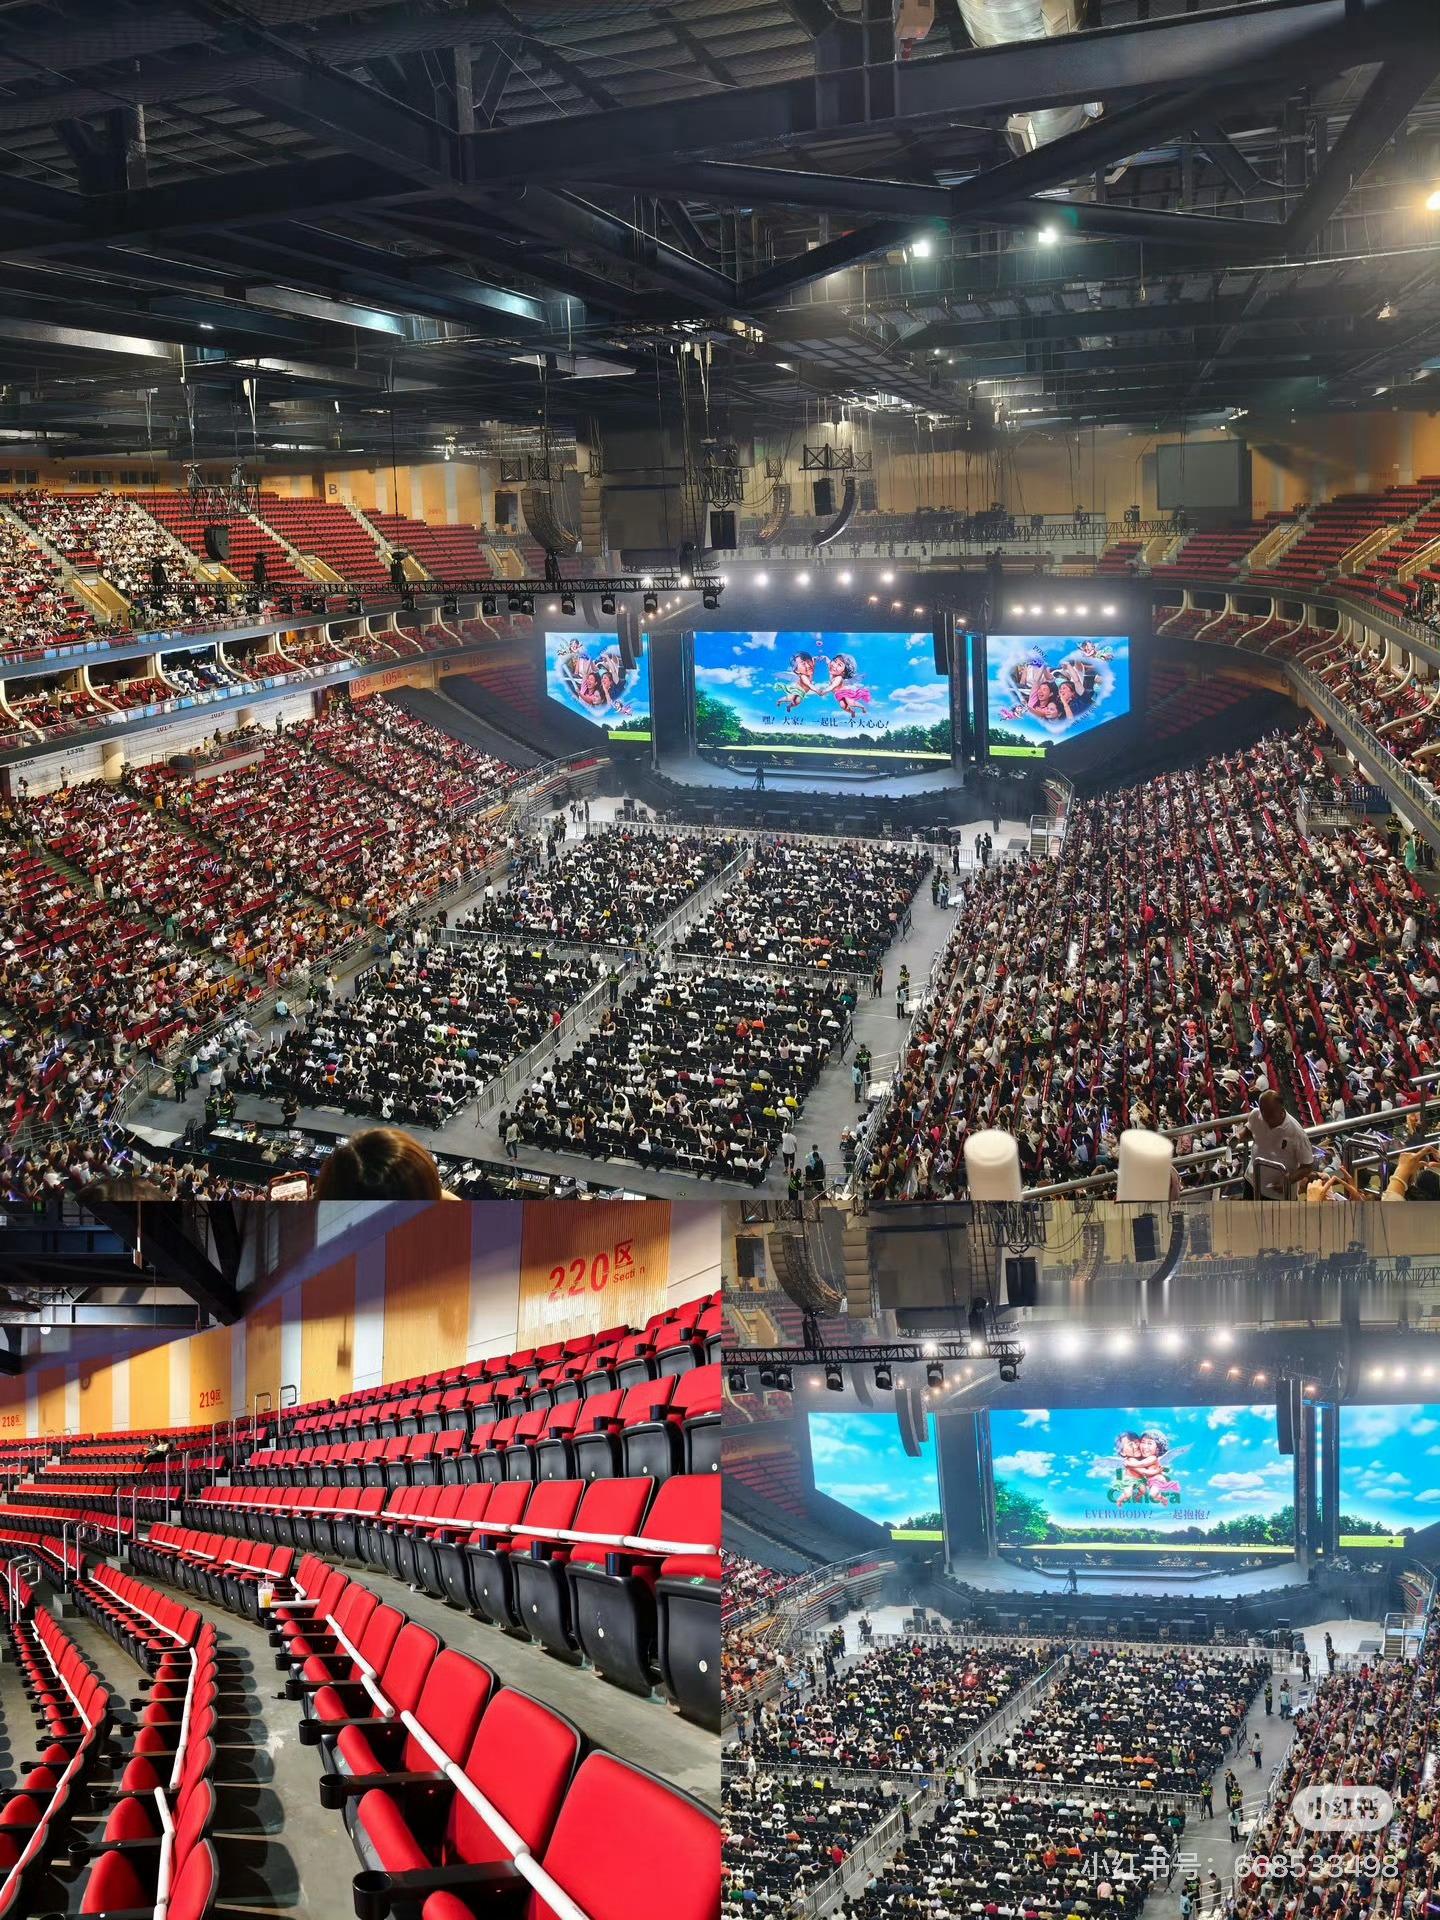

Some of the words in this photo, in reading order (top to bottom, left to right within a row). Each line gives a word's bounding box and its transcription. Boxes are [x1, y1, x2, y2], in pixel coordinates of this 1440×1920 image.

[328, 483, 338, 495] B
[547, 1238, 634, 1304] 220区
[612, 1265, 646, 1284] Sectin
